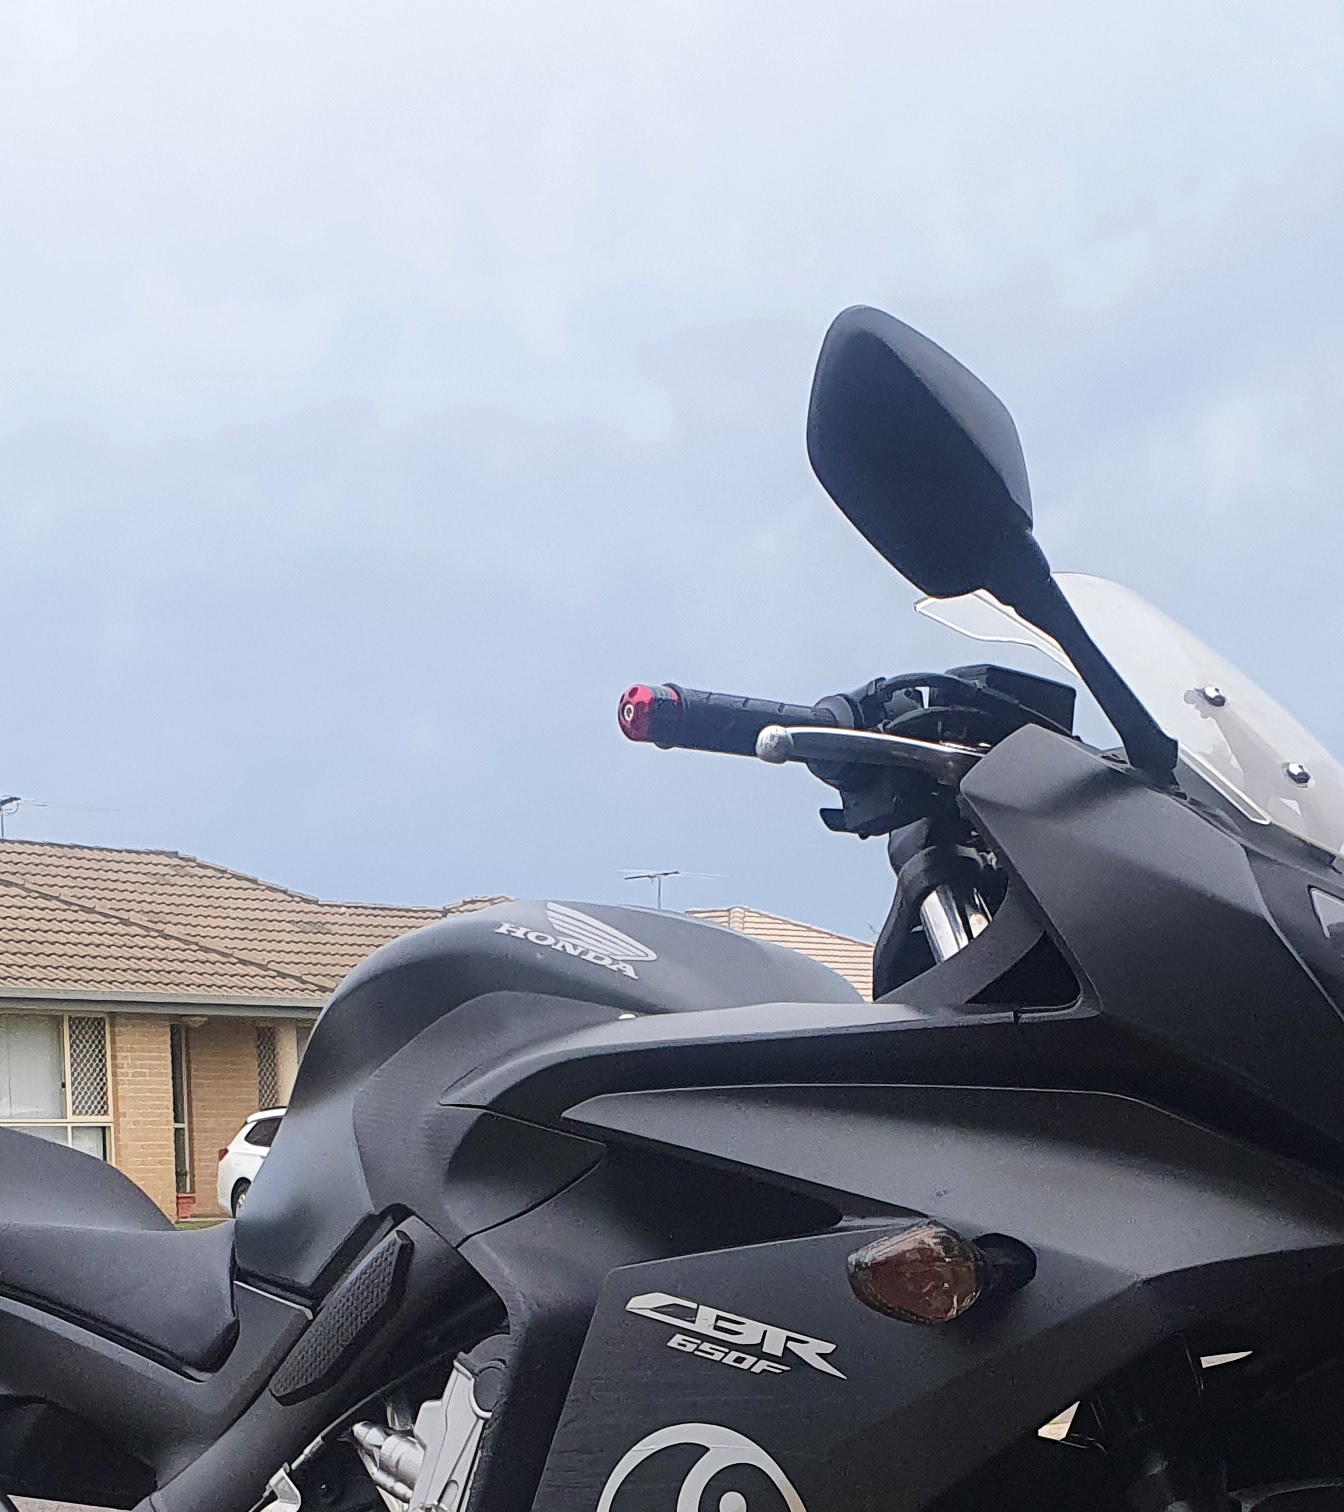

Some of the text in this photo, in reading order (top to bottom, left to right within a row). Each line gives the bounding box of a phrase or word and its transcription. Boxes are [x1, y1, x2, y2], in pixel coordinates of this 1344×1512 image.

[494, 921, 639, 980] HONDA
[625, 1292, 848, 1380] CBR
[666, 1333, 792, 1374] 650F
